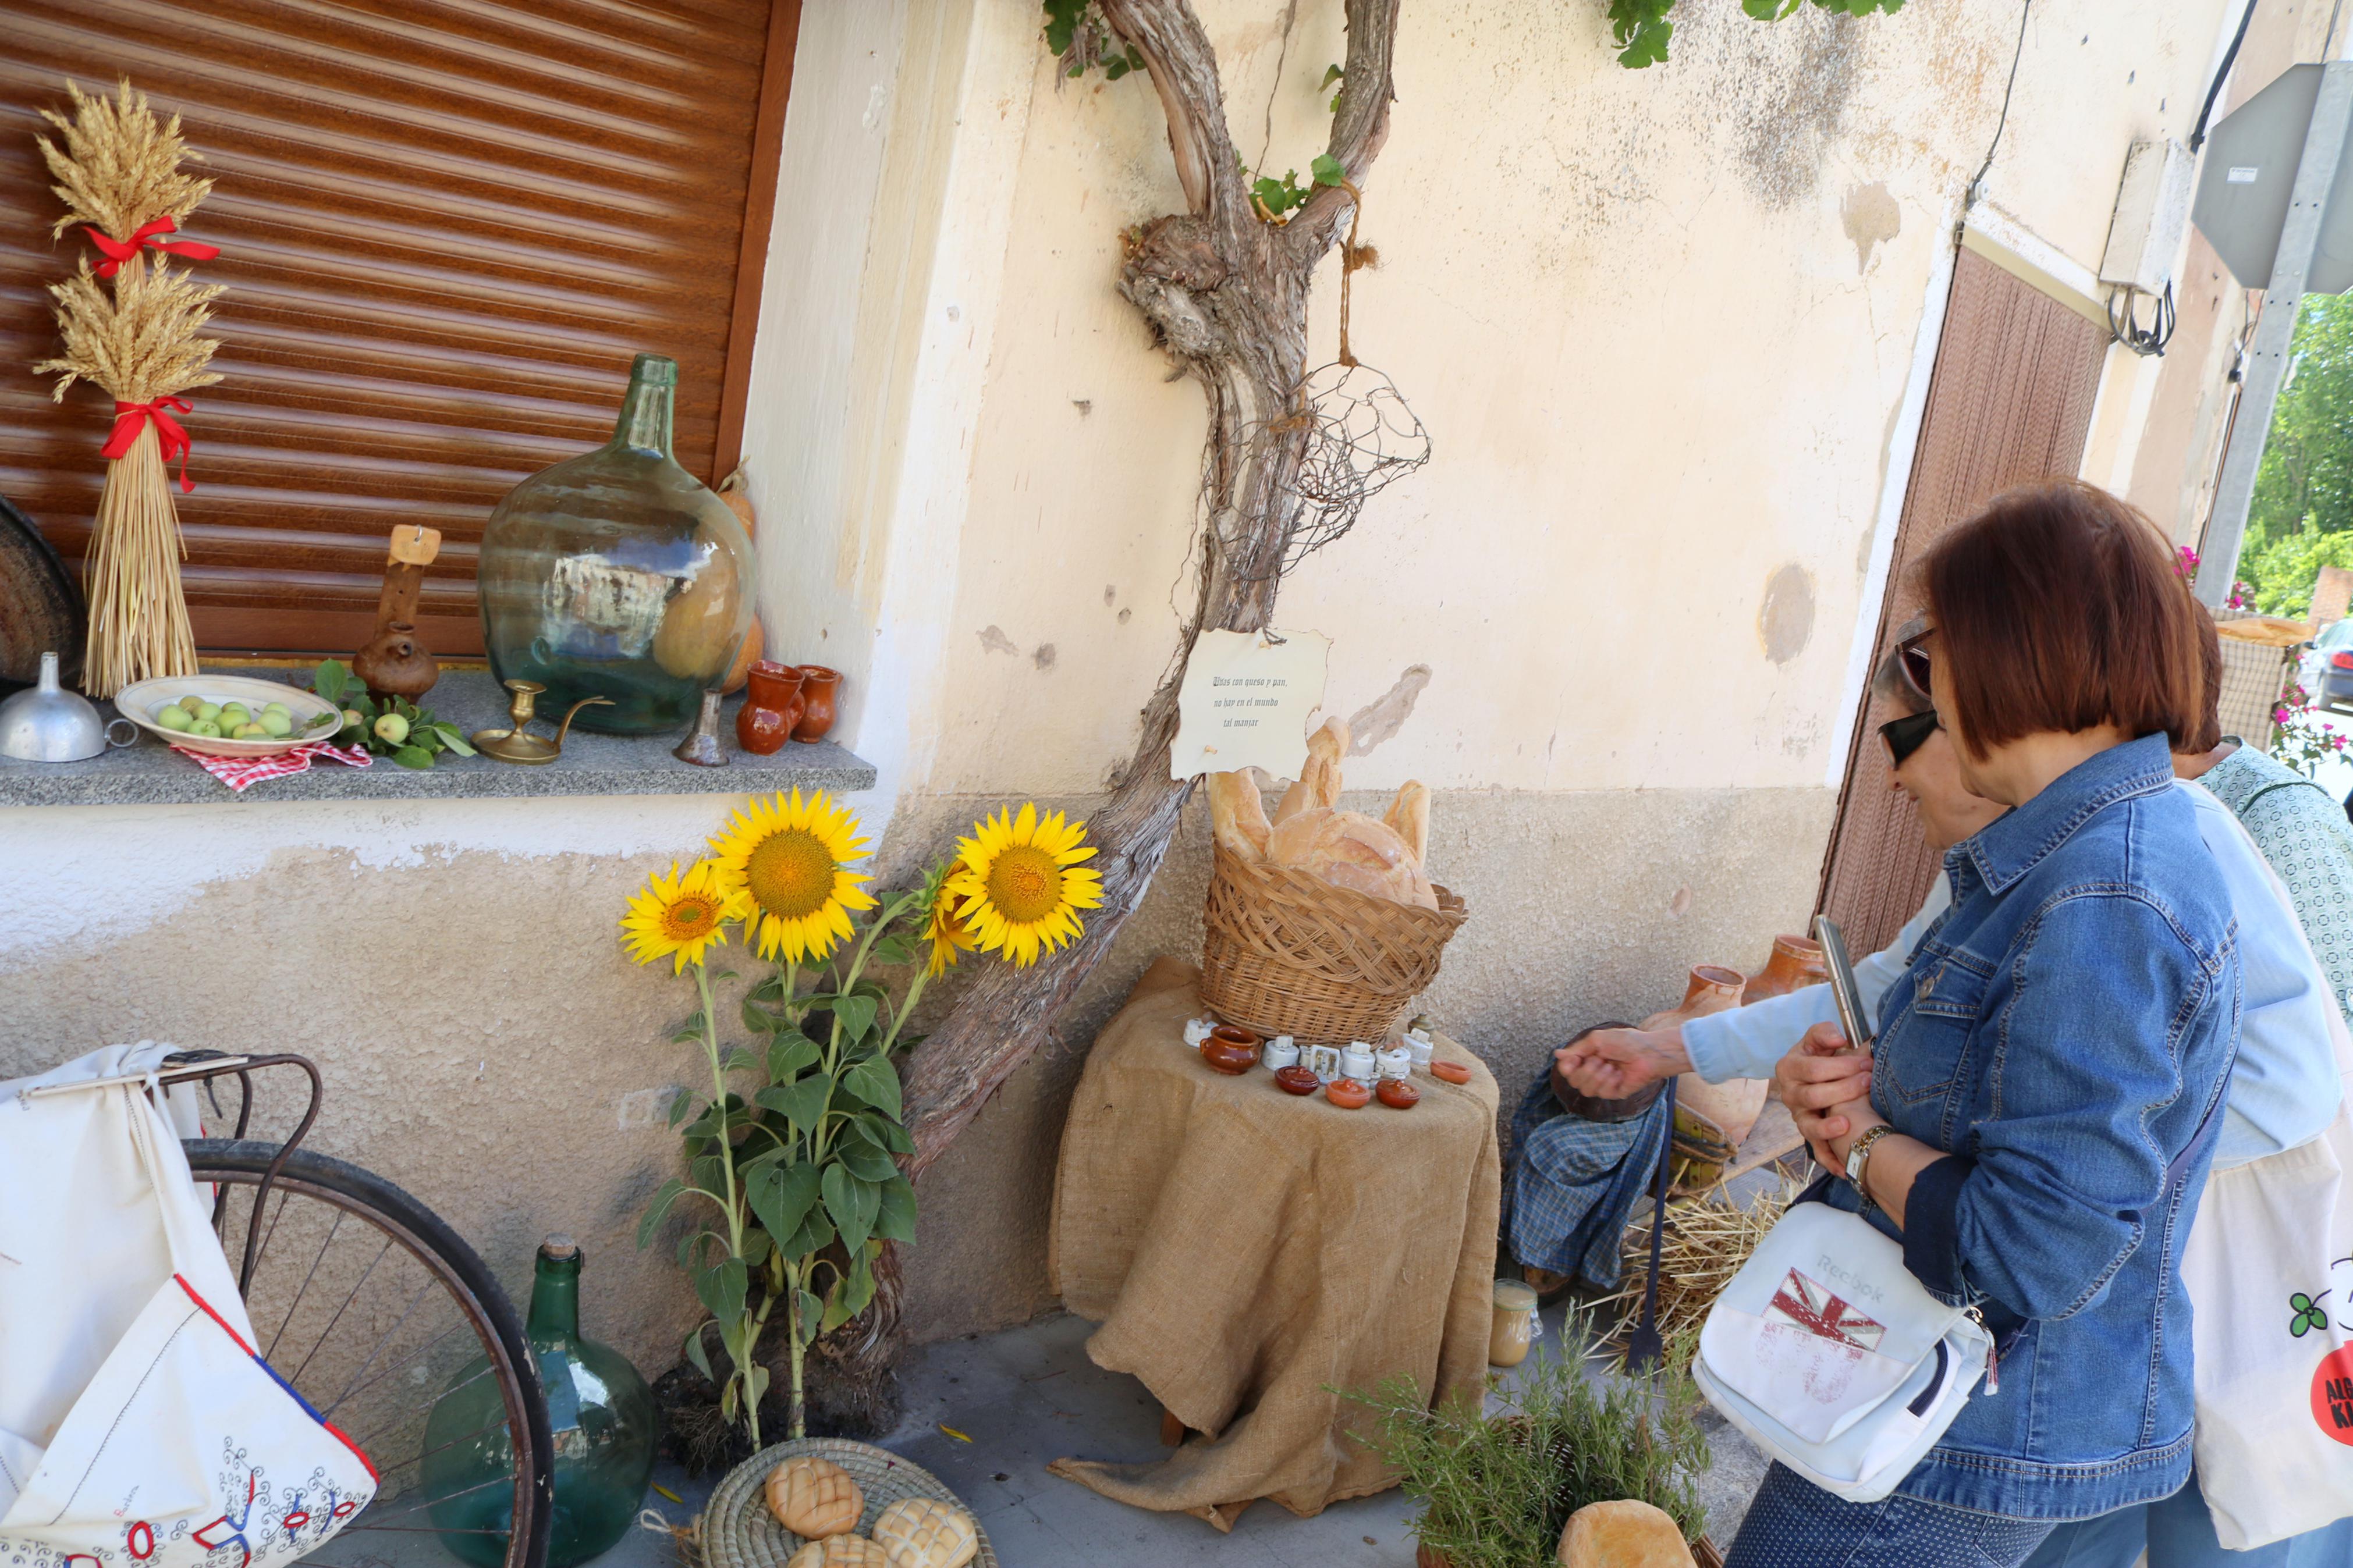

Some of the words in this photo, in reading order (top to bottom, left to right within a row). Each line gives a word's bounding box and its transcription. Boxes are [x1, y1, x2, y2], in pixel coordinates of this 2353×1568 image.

[1212, 677, 1231, 687] Uvas
[1244, 678, 1265, 687] queso
[1266, 678, 1272, 688] y
[1272, 679, 1288, 687] pan,
[1224, 698, 1235, 708] hay
[1246, 697, 1253, 706] el
[1254, 698, 1279, 706] mundo
[1223, 718, 1233, 727] tal
[1234, 719, 1259, 727] manjar
[1817, 1254, 1884, 1303] Reebok
